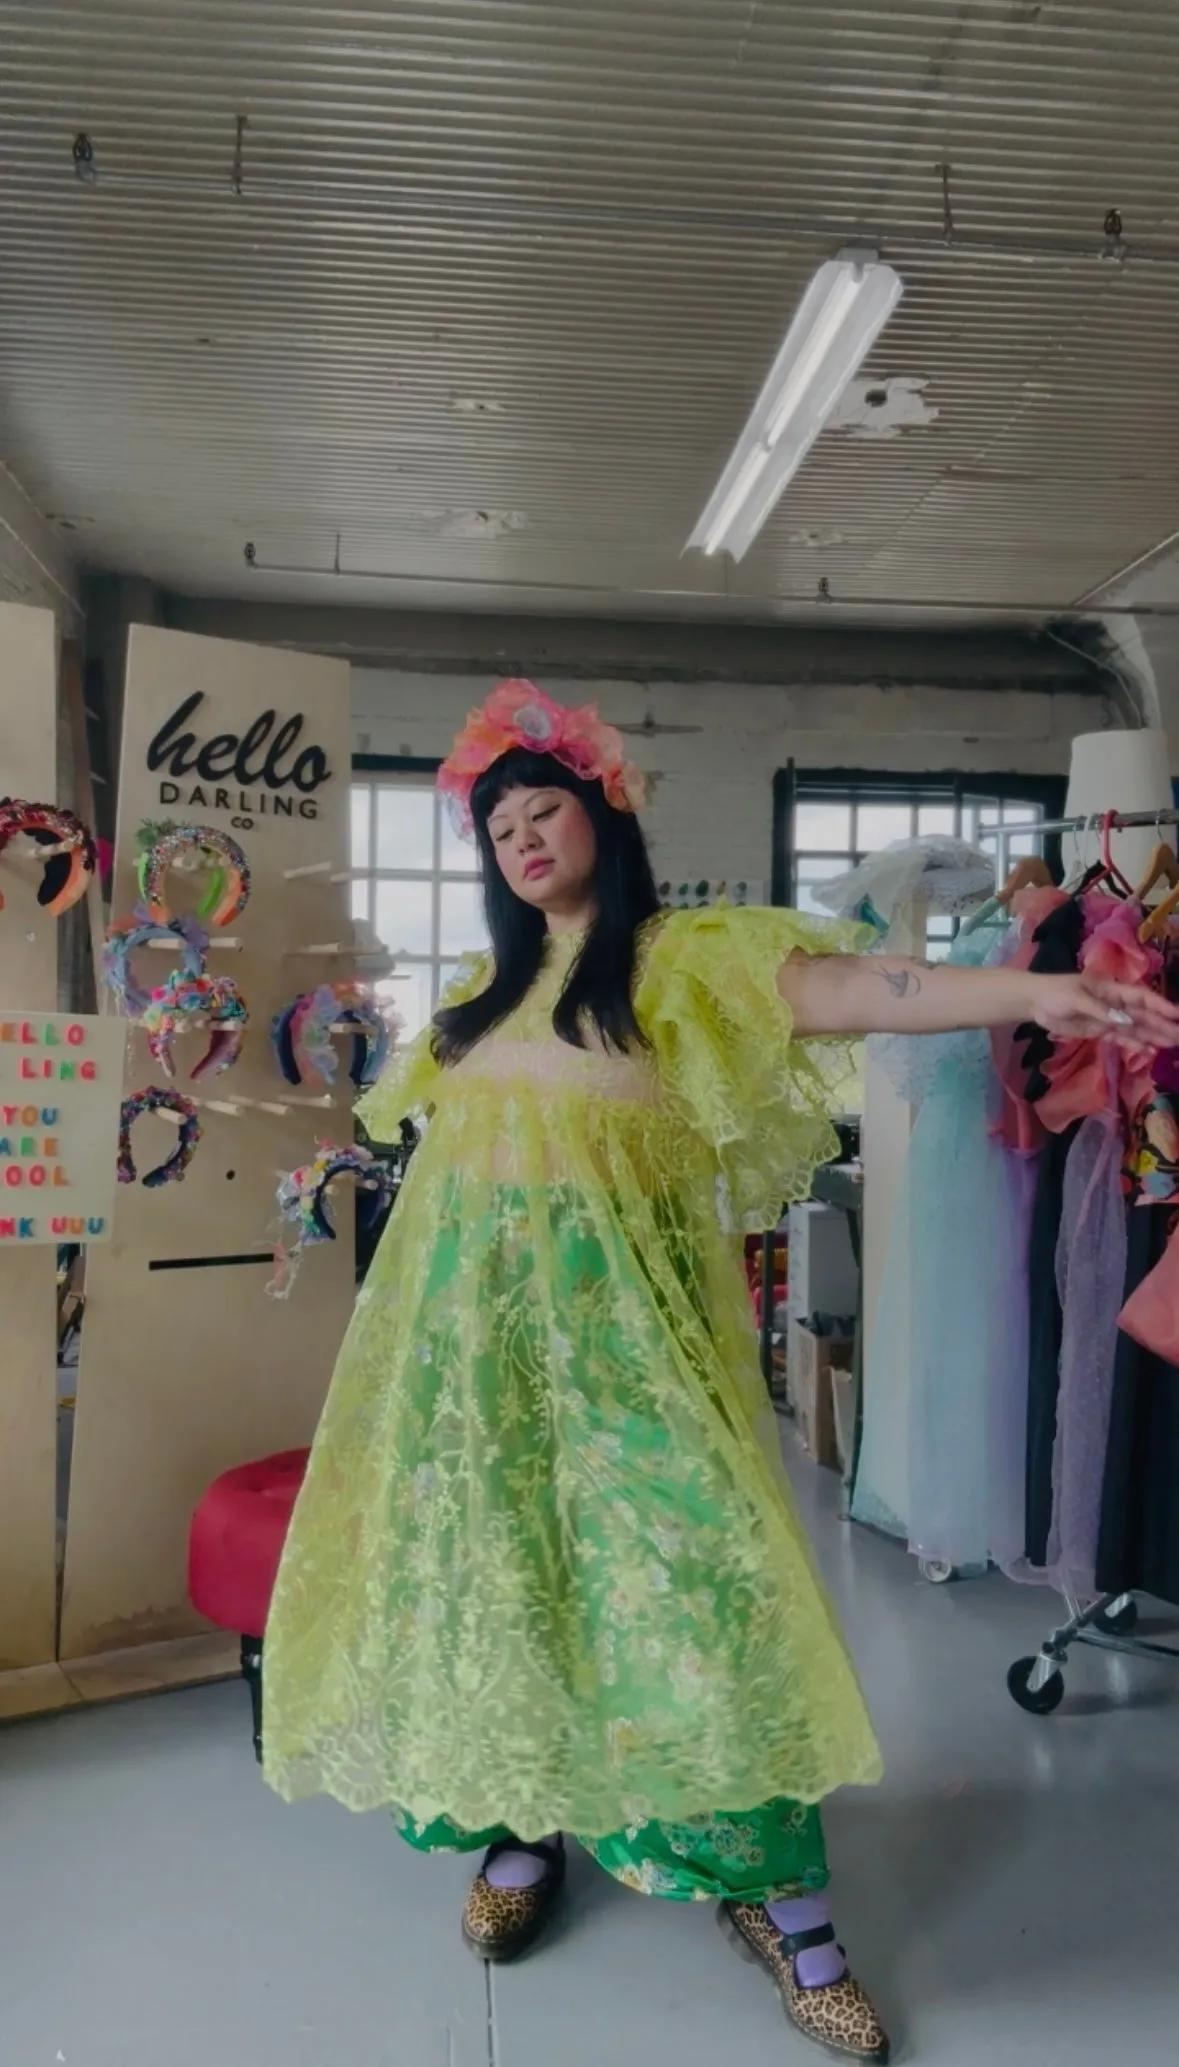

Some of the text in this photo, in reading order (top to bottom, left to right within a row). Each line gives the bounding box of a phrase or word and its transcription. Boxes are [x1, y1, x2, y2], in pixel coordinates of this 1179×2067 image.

[146, 689, 332, 793] hello
[159, 781, 318, 819] DARLING
[230, 816, 255, 830] CO
[20, 1057, 97, 1080] LING
[1, 1105, 59, 1127] YOU
[50, 1216, 104, 1235] UUU
